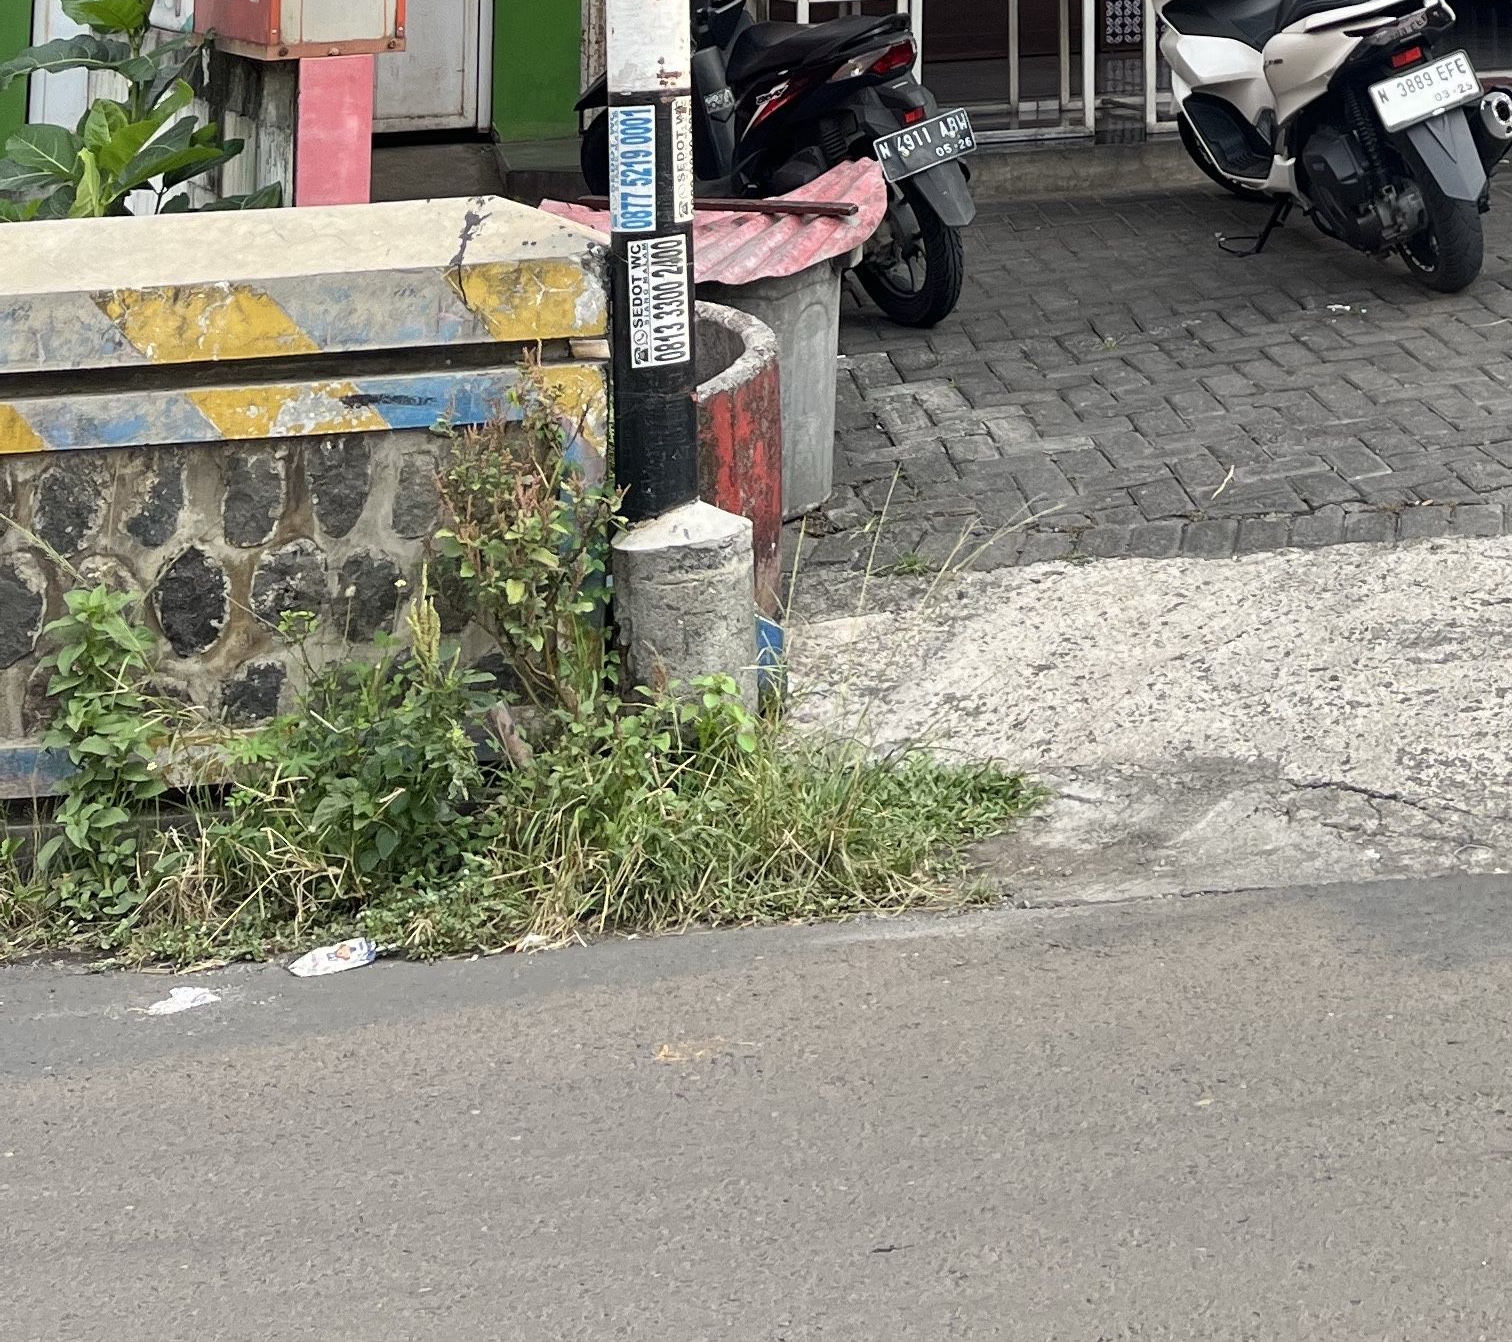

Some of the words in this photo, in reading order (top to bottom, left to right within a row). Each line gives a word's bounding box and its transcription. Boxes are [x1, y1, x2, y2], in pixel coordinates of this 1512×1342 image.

[1377, 88, 1390, 104] N
[1396, 71, 1434, 97] 3889
[1435, 57, 1467, 82] EFE
[620, 108, 653, 145] 0001
[879, 141, 892, 160] N
[897, 126, 932, 153] 4911
[620, 149, 653, 187] 5219
[676, 131, 685, 183] SEDOT
[620, 192, 653, 229] 0877
[630, 243, 642, 270] WC
[641, 242, 649, 284] MALAM
[650, 239, 684, 278] 2400
[631, 274, 644, 329] SEDOT
[652, 280, 686, 320] 3300
[652, 322, 687, 362] 0813
